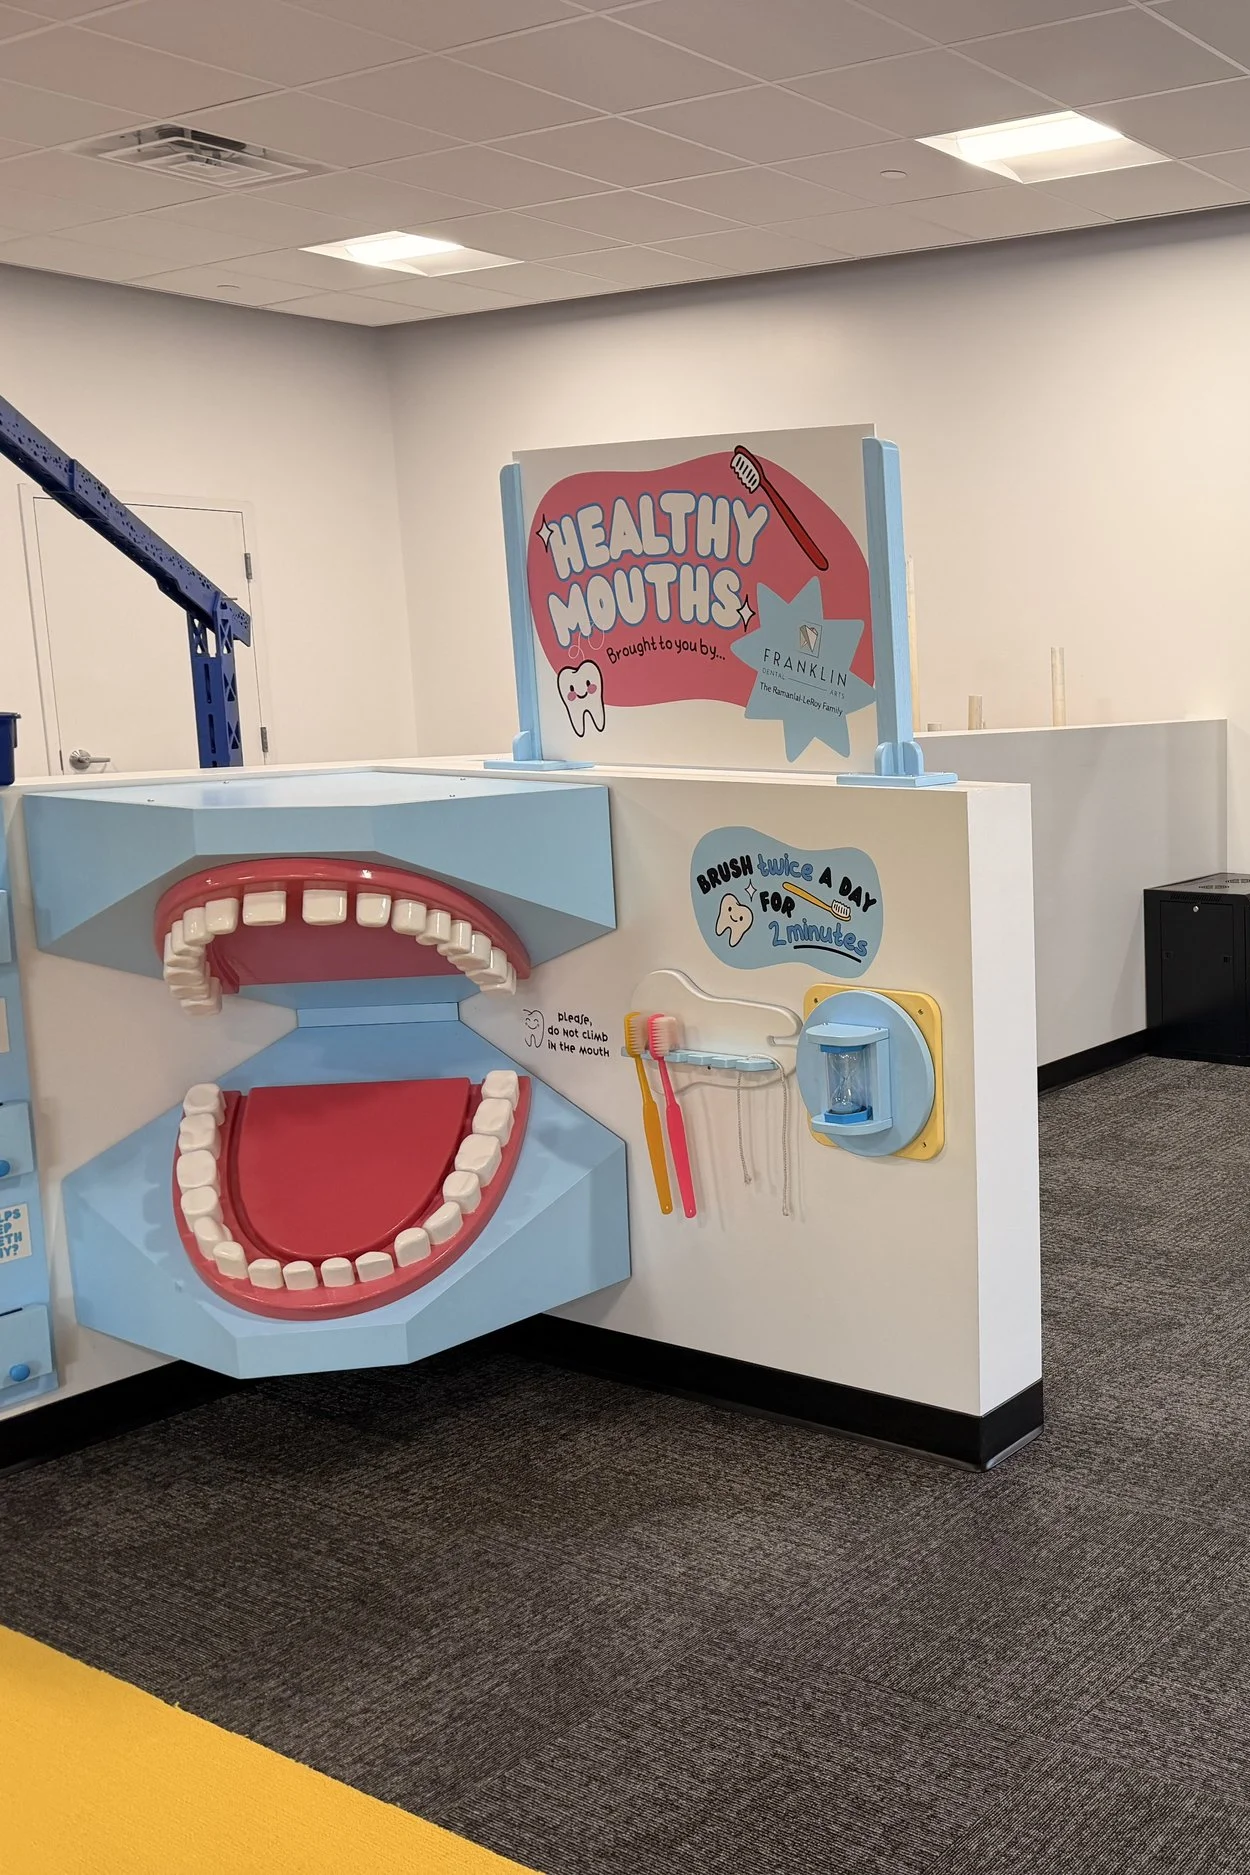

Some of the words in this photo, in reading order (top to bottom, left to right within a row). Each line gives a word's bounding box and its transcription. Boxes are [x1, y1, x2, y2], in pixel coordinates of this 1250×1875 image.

[547, 490, 769, 581] HEALTHY
[547, 562, 743, 648] MOUTHS
[606, 636, 657, 664] Brought
[659, 635, 673, 650] to
[674, 639, 697, 654] you
[762, 667, 786, 681] DENTAL
[763, 648, 848, 687] FRANKLIN
[760, 682, 772, 693] The
[822, 702, 844, 717] Family
[696, 854, 753, 894] BRUSH
[757, 853, 813, 881] twice
[818, 867, 832, 888] A
[838, 876, 877, 913] DAY
[759, 890, 795, 918] FOR
[768, 920, 786, 946] 2
[786, 918, 868, 957] minutes
[547, 1025, 560, 1036] do
[582, 1030, 609, 1042] climb
[547, 1039, 557, 1051] in
[559, 1041, 576, 1053] the
[579, 1045, 610, 1057] mouth
